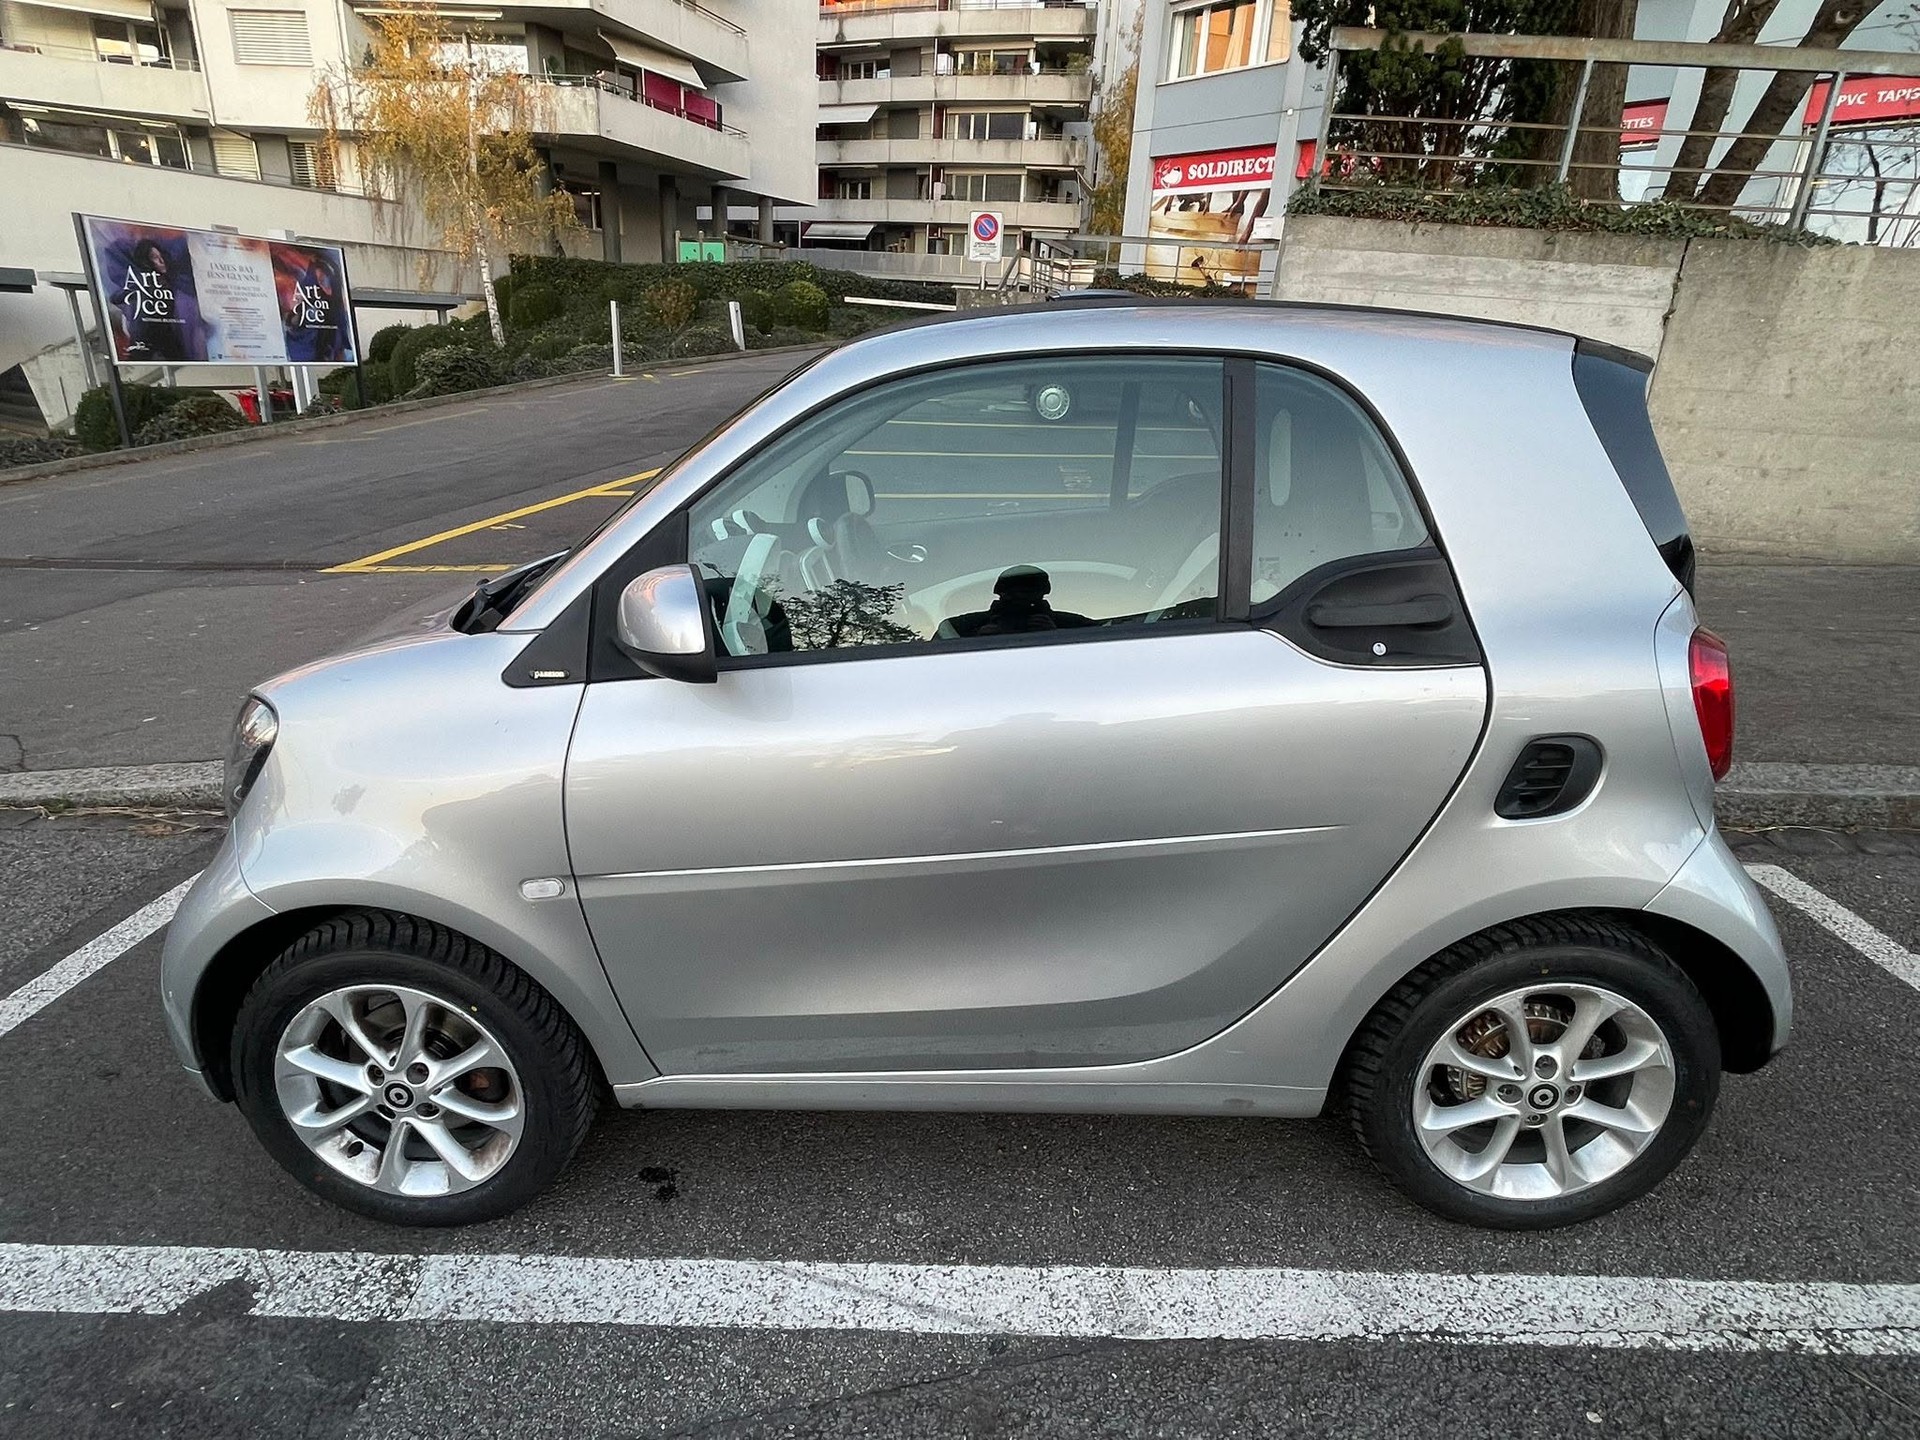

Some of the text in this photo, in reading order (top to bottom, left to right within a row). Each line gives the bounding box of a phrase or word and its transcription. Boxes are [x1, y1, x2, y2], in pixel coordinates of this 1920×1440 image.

[1836, 93, 1868, 107] PVC
[1188, 156, 1275, 180] SOLDIRECT
[123, 265, 163, 298] Art
[124, 290, 168, 320] Ice
[153, 288, 174, 300] on
[293, 280, 321, 308] Art
[314, 300, 329, 310] on
[293, 301, 325, 326] Ice
